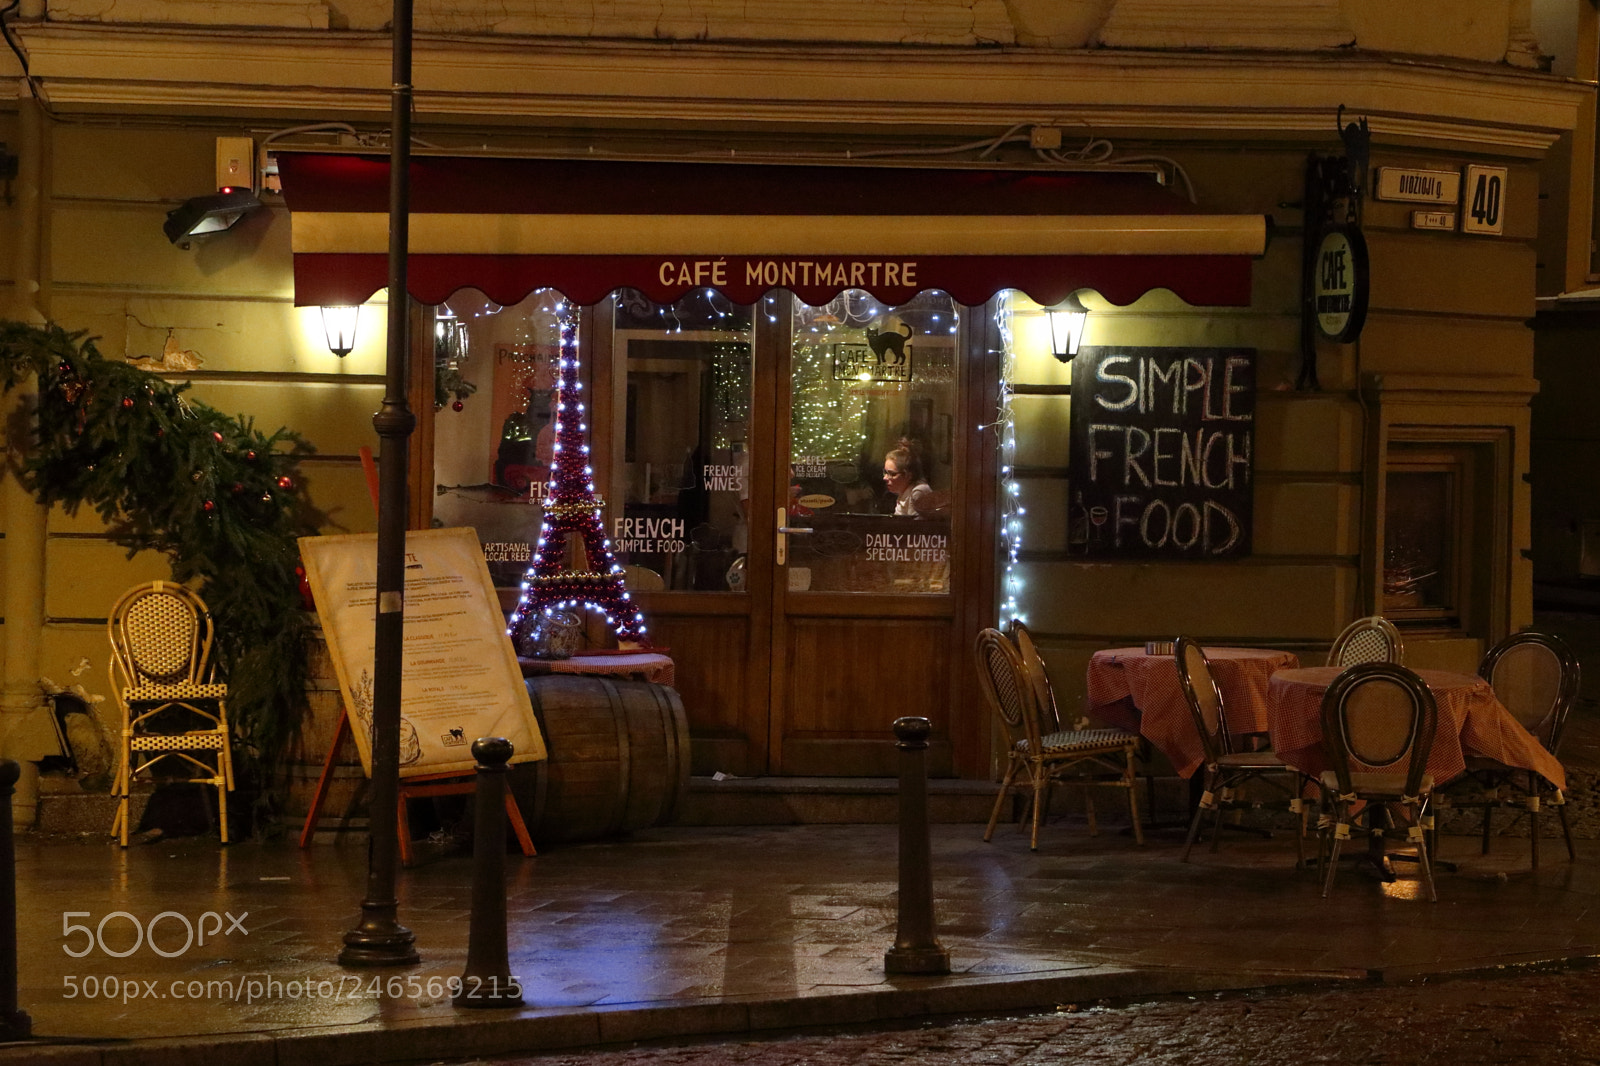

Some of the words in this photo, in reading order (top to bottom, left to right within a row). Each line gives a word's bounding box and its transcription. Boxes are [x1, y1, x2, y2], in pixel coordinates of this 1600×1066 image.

[1471, 174, 1501, 226] 40
[658, 256, 728, 286] CAFÉ
[745, 261, 918, 287] MONTMARTRE
[1321, 243, 1347, 290] CAFÉ
[838, 365, 907, 377] MONTMARTRE
[1093, 355, 1252, 422] SIMPLE
[1088, 424, 1251, 490] FRENCH
[703, 464, 743, 477] FRENCH
[530, 481, 551, 498] FIS
[703, 477, 743, 491] WINES
[613, 517, 685, 539] FRENCH
[1113, 496, 1241, 555] FOOD
[484, 542, 531, 553] ARTISANAL
[614, 539, 653, 553] SIMPLE
[657, 539, 685, 553] FOOD
[865, 533, 904, 548] DAILY
[906, 534, 947, 549] LUNCH
[484, 552, 509, 562] LOCAL
[511, 552, 531, 562] BEER
[865, 548, 911, 561] SPECIAL
[913, 549, 947, 562] OFFER
